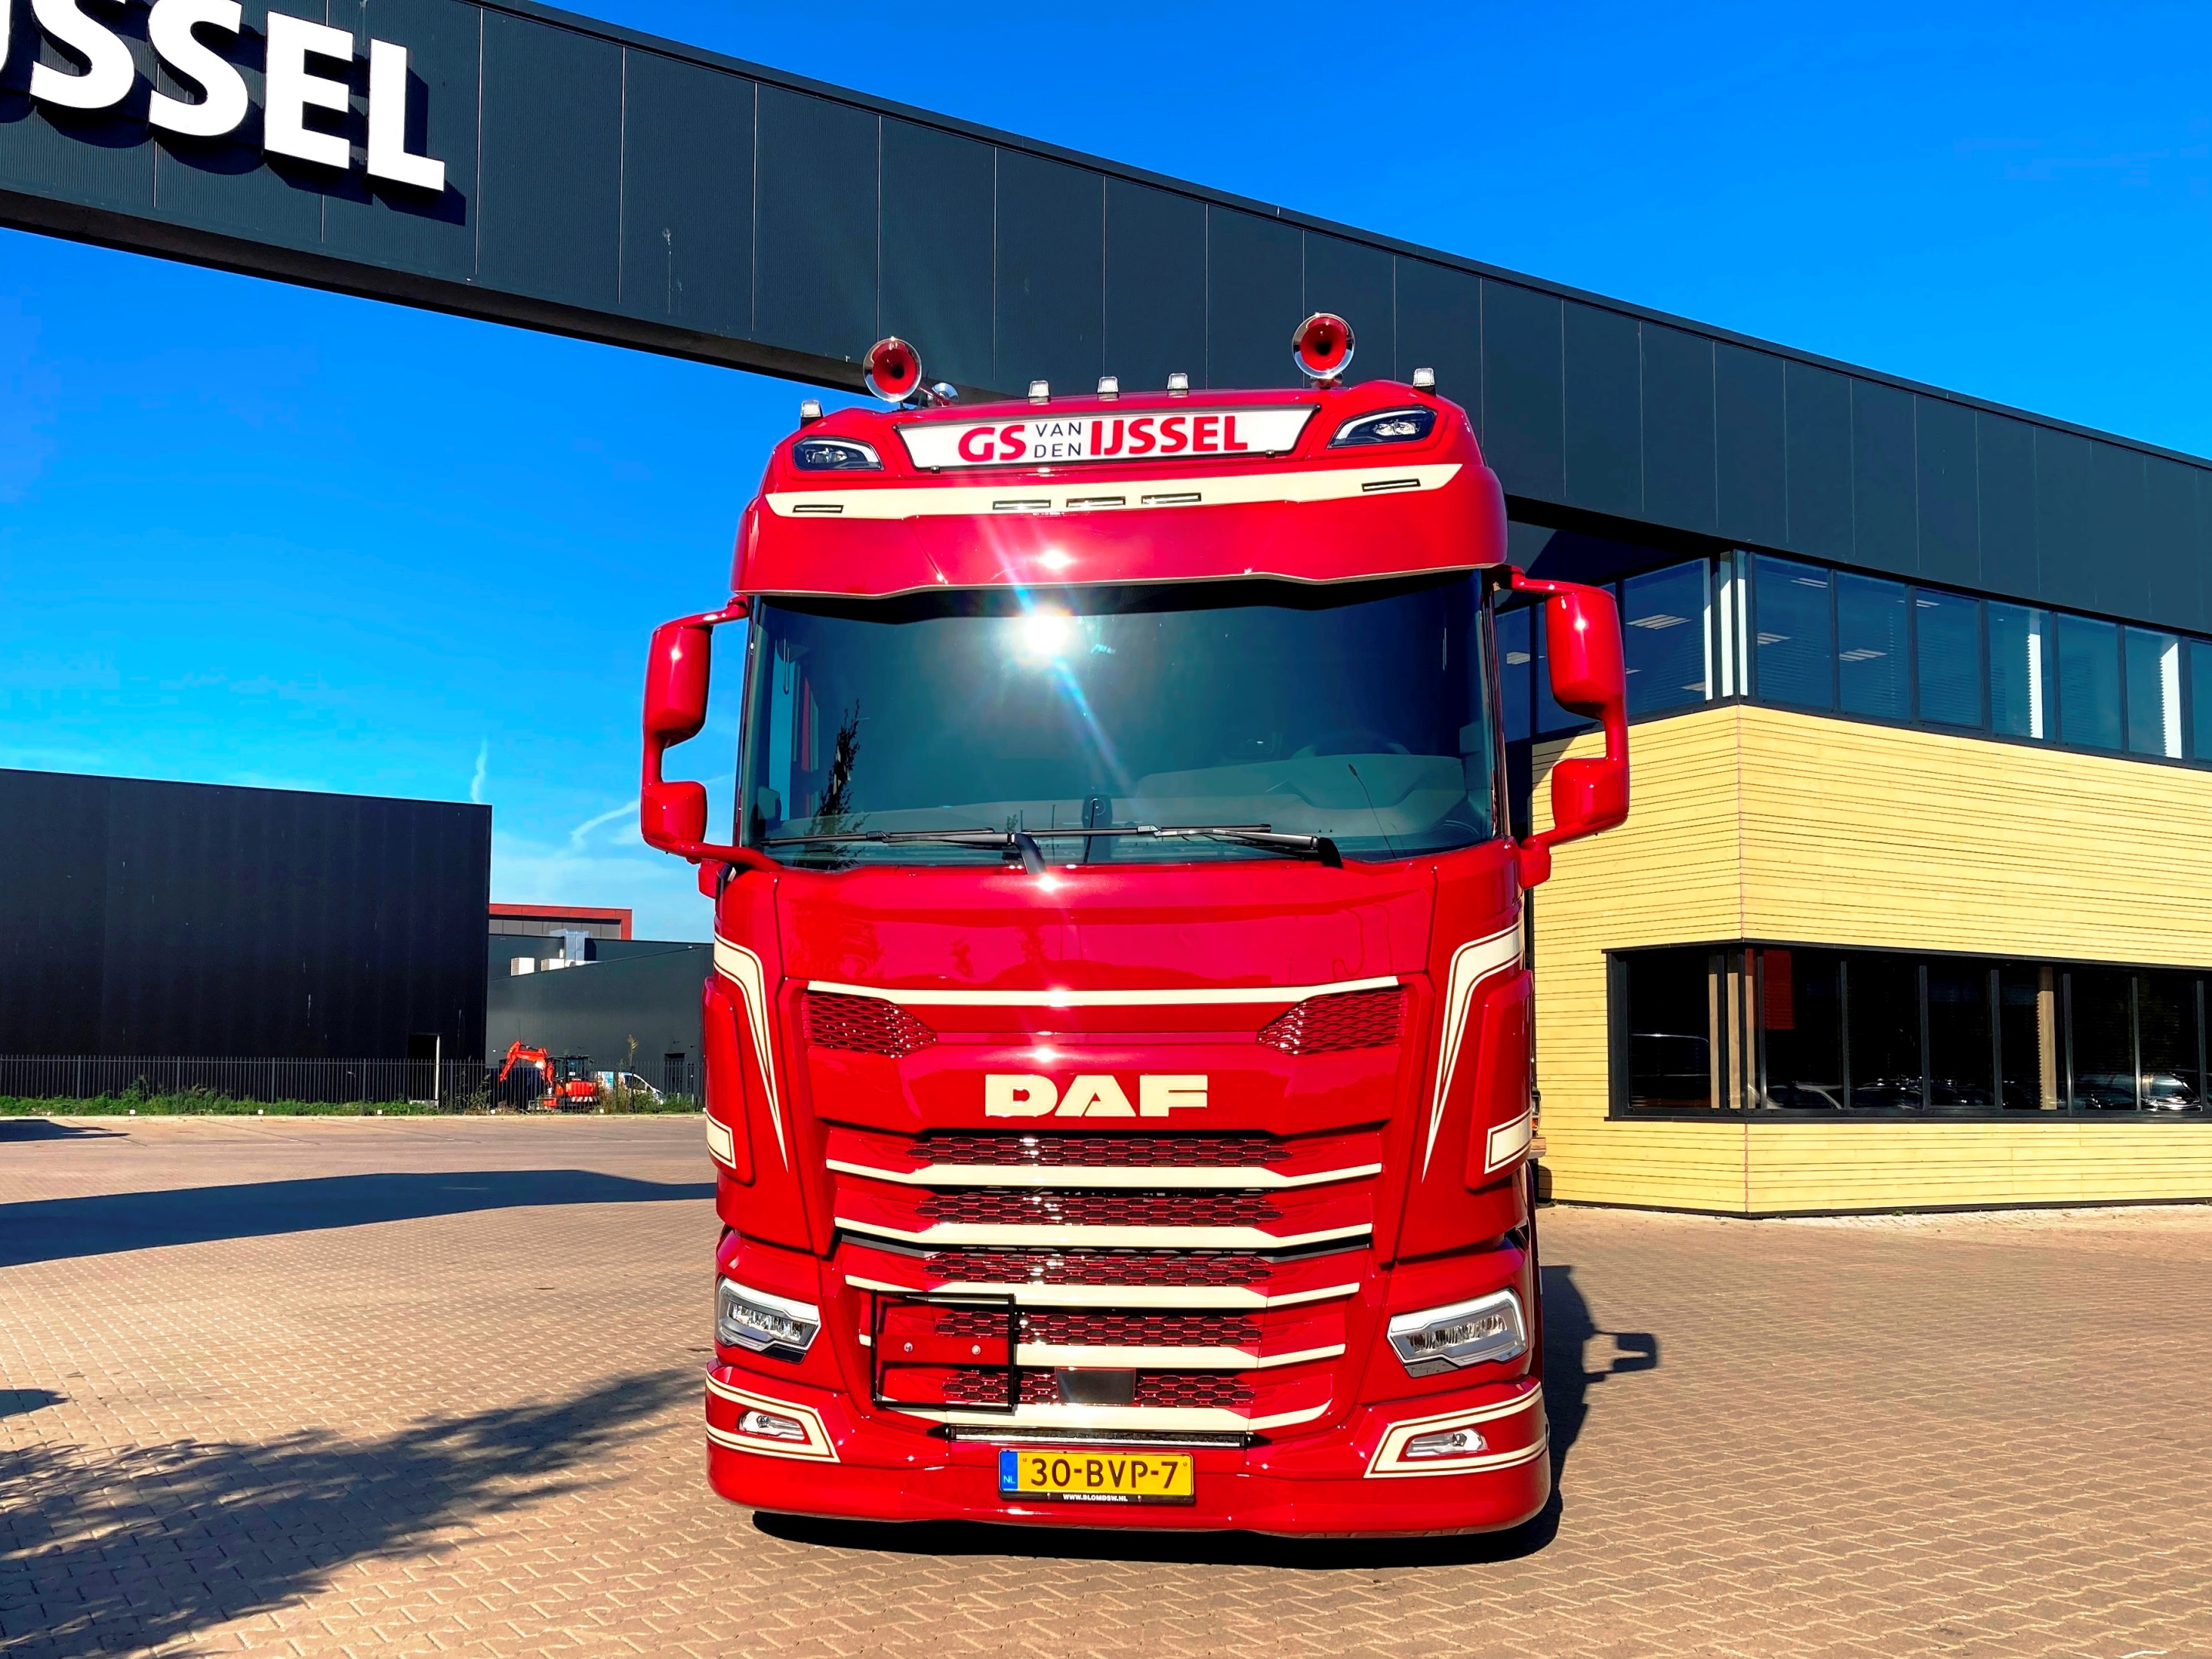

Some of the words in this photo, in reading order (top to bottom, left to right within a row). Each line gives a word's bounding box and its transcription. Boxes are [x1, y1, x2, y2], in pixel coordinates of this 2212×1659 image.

[0, 0, 444, 191] SSEL
[957, 425, 1026, 462] GS
[1035, 422, 1081, 438] VAN
[1090, 416, 1248, 456] IJSSEL
[1034, 443, 1081, 458] DEN
[985, 1074, 1208, 1117] DAF
[1003, 1475, 1016, 1484] NL
[1031, 1458, 1178, 1489] 30-BVP-7
